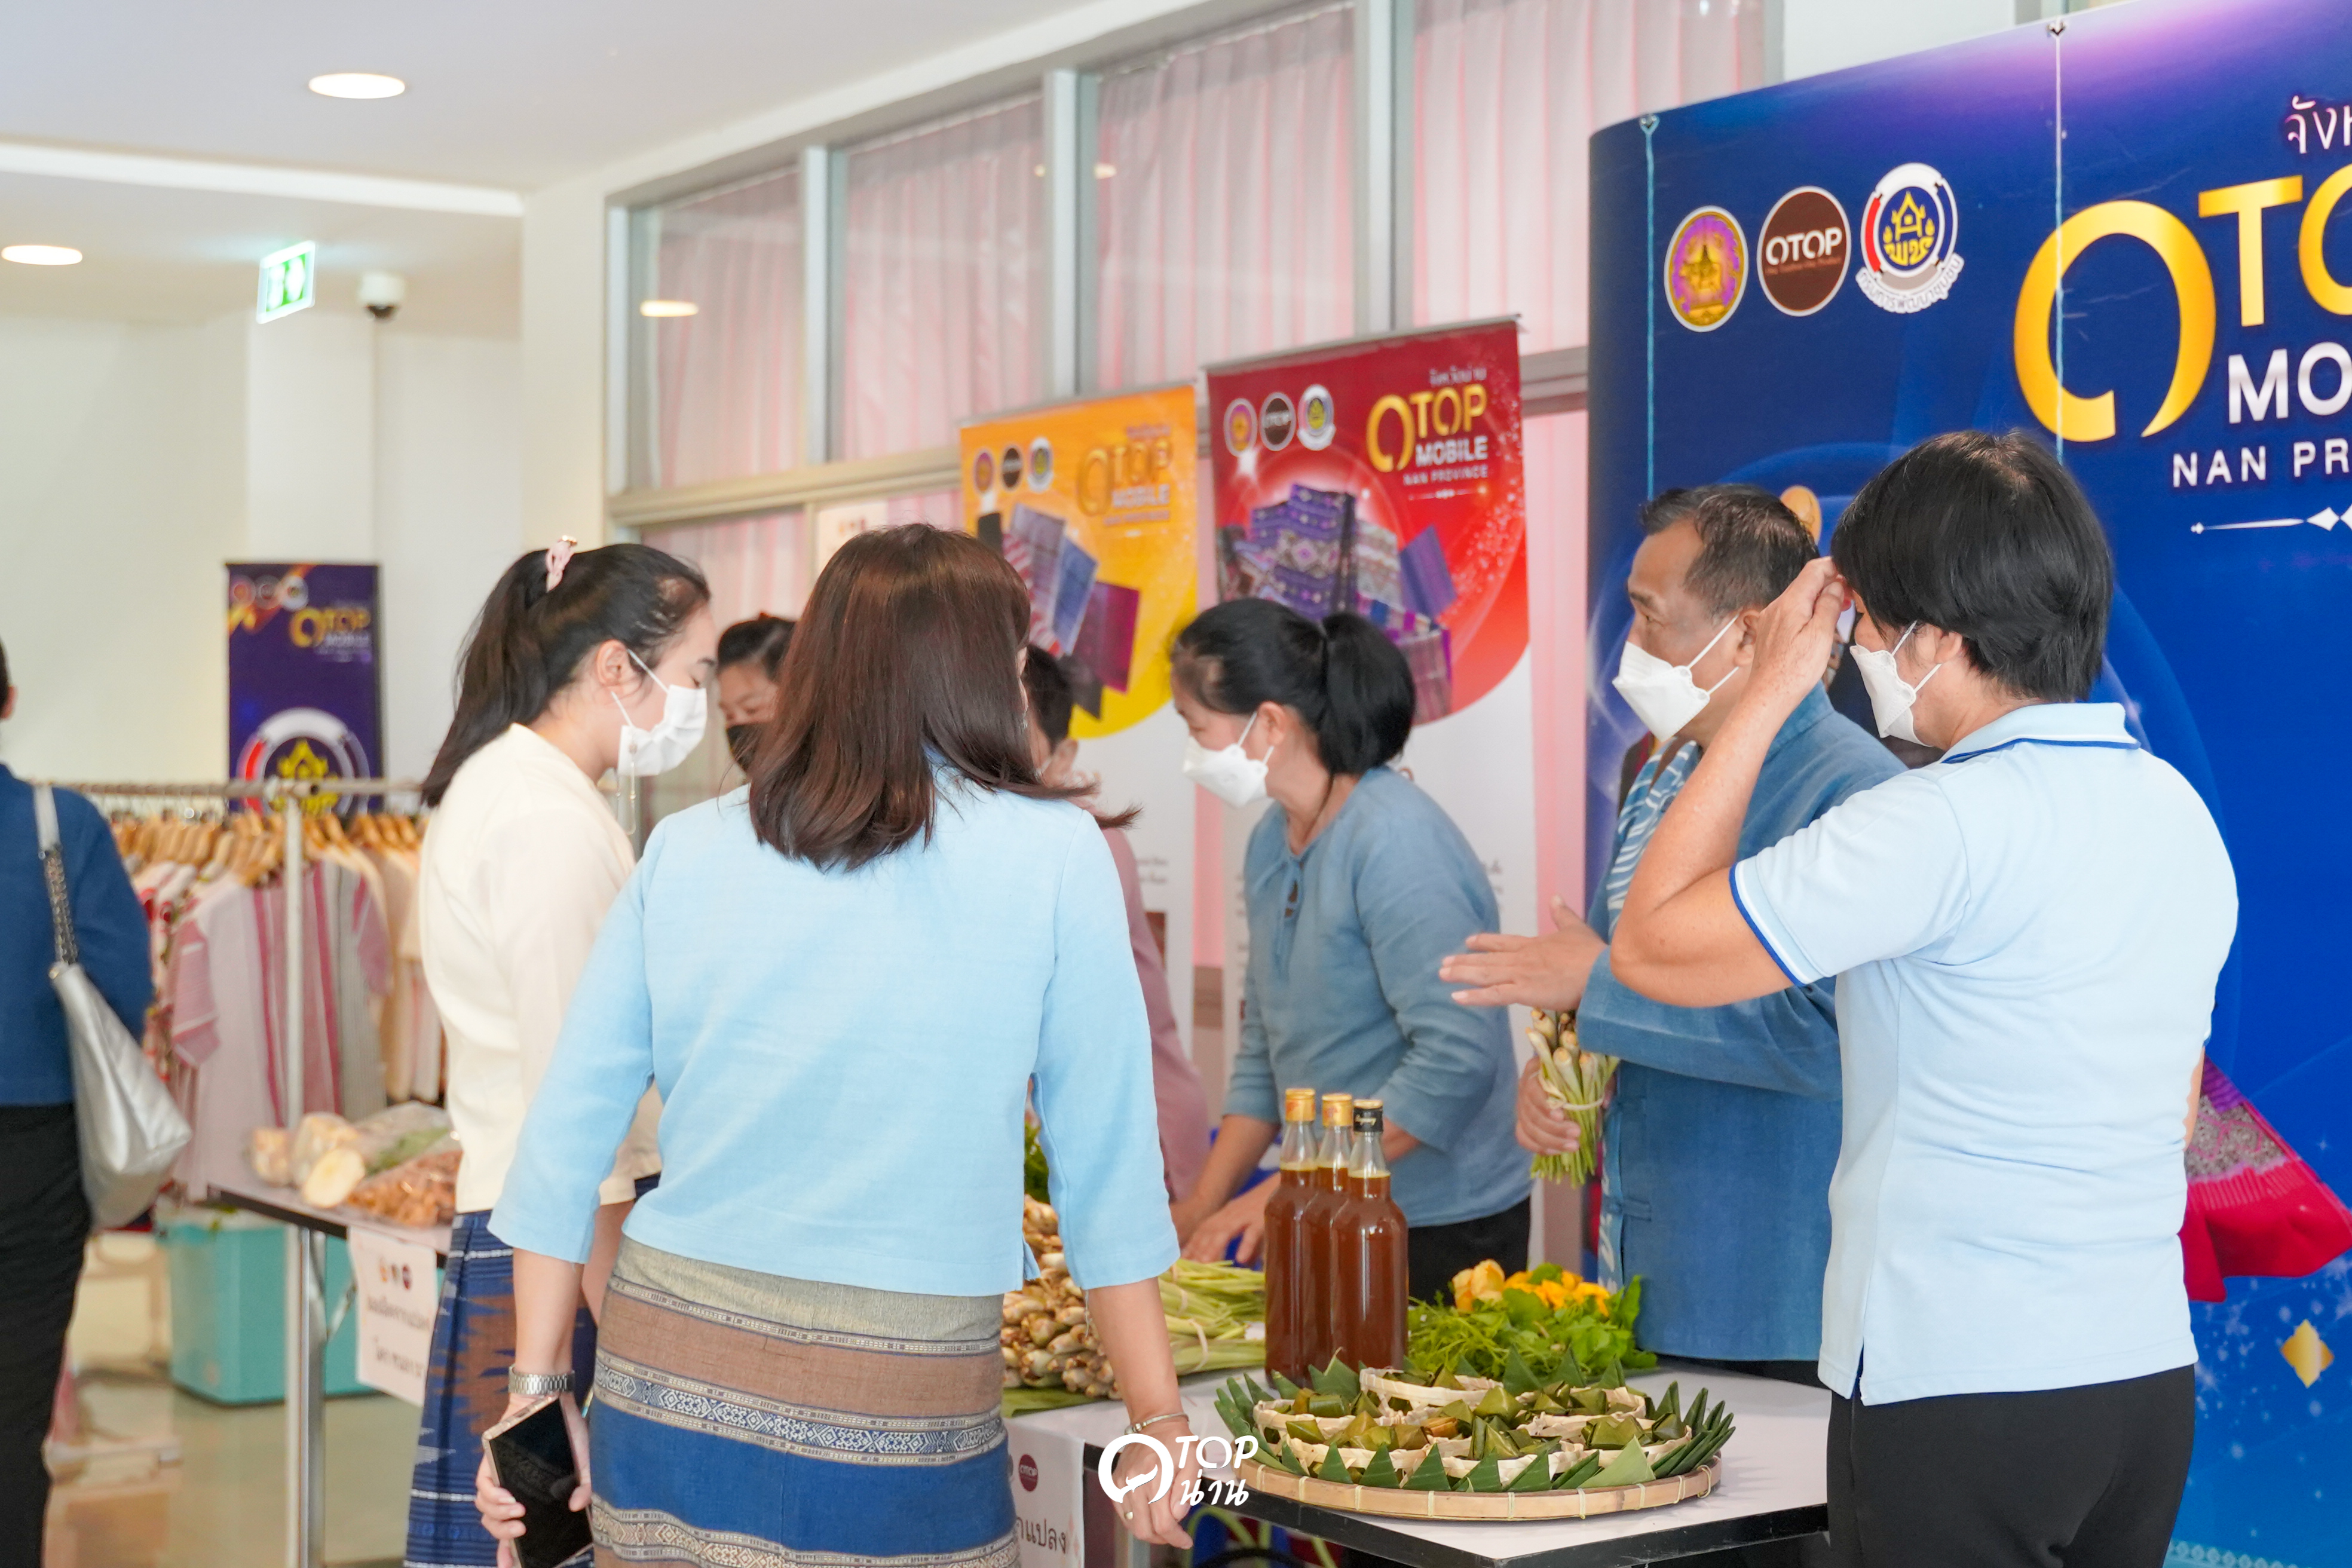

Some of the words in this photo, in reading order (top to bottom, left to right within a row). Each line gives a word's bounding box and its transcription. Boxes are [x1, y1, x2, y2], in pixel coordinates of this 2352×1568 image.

[1766, 226, 1843, 266] OTOP
[1366, 383, 1487, 473] OTOP
[1415, 435, 1489, 467] MOBILE
[2173, 446, 2267, 488] NAN
